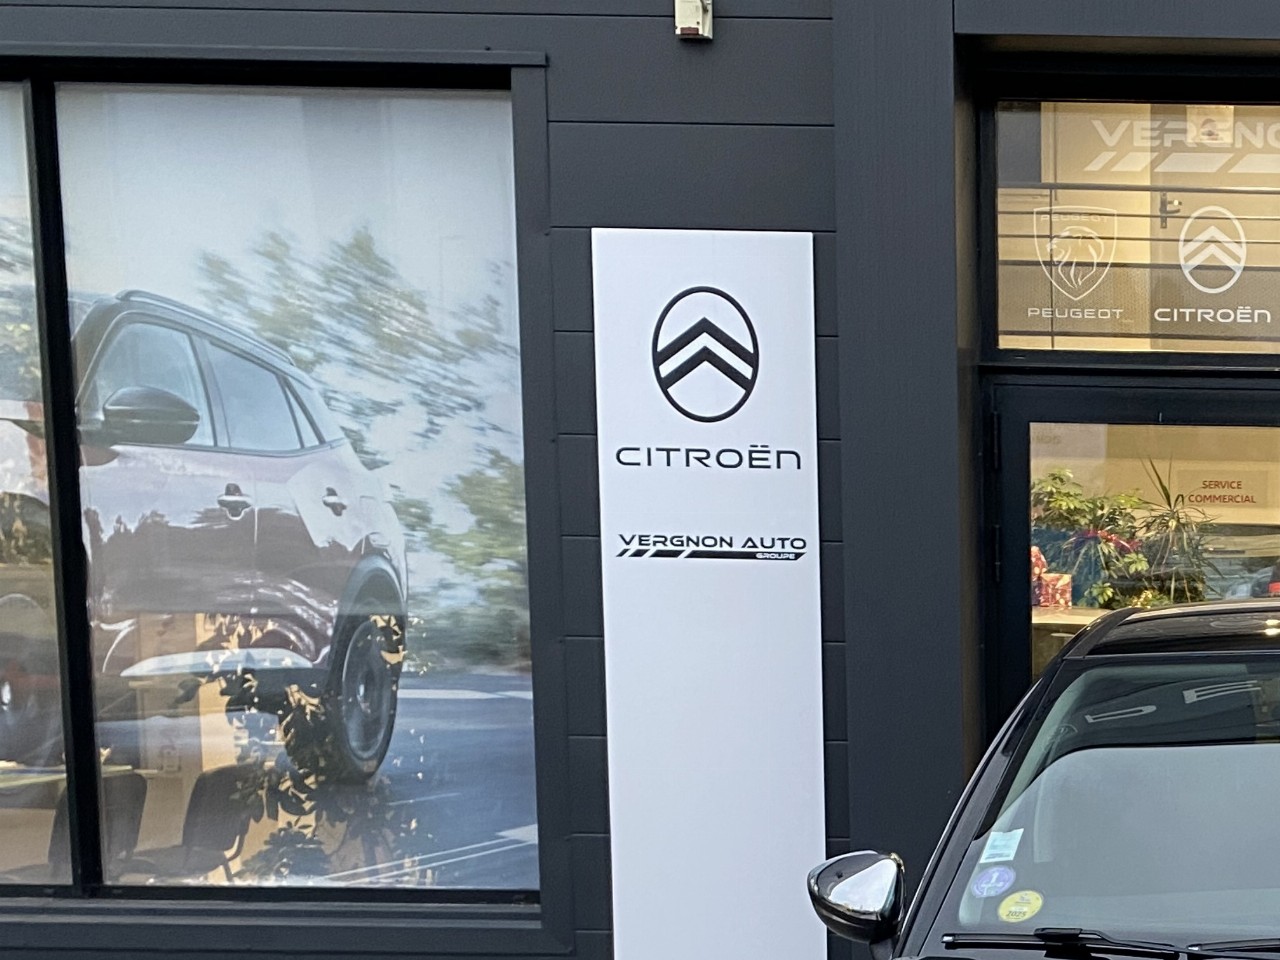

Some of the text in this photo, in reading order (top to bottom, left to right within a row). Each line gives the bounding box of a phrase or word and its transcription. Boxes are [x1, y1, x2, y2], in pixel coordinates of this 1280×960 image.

[1027, 307, 1124, 319] PEUGEOT
[615, 444, 802, 470] CITROËN
[1201, 480, 1243, 490] SERVICE
[1187, 494, 1257, 504] COMMERCIAL
[618, 533, 808, 550] VERGNON AUTO
[755, 552, 796, 561] GROUPE
